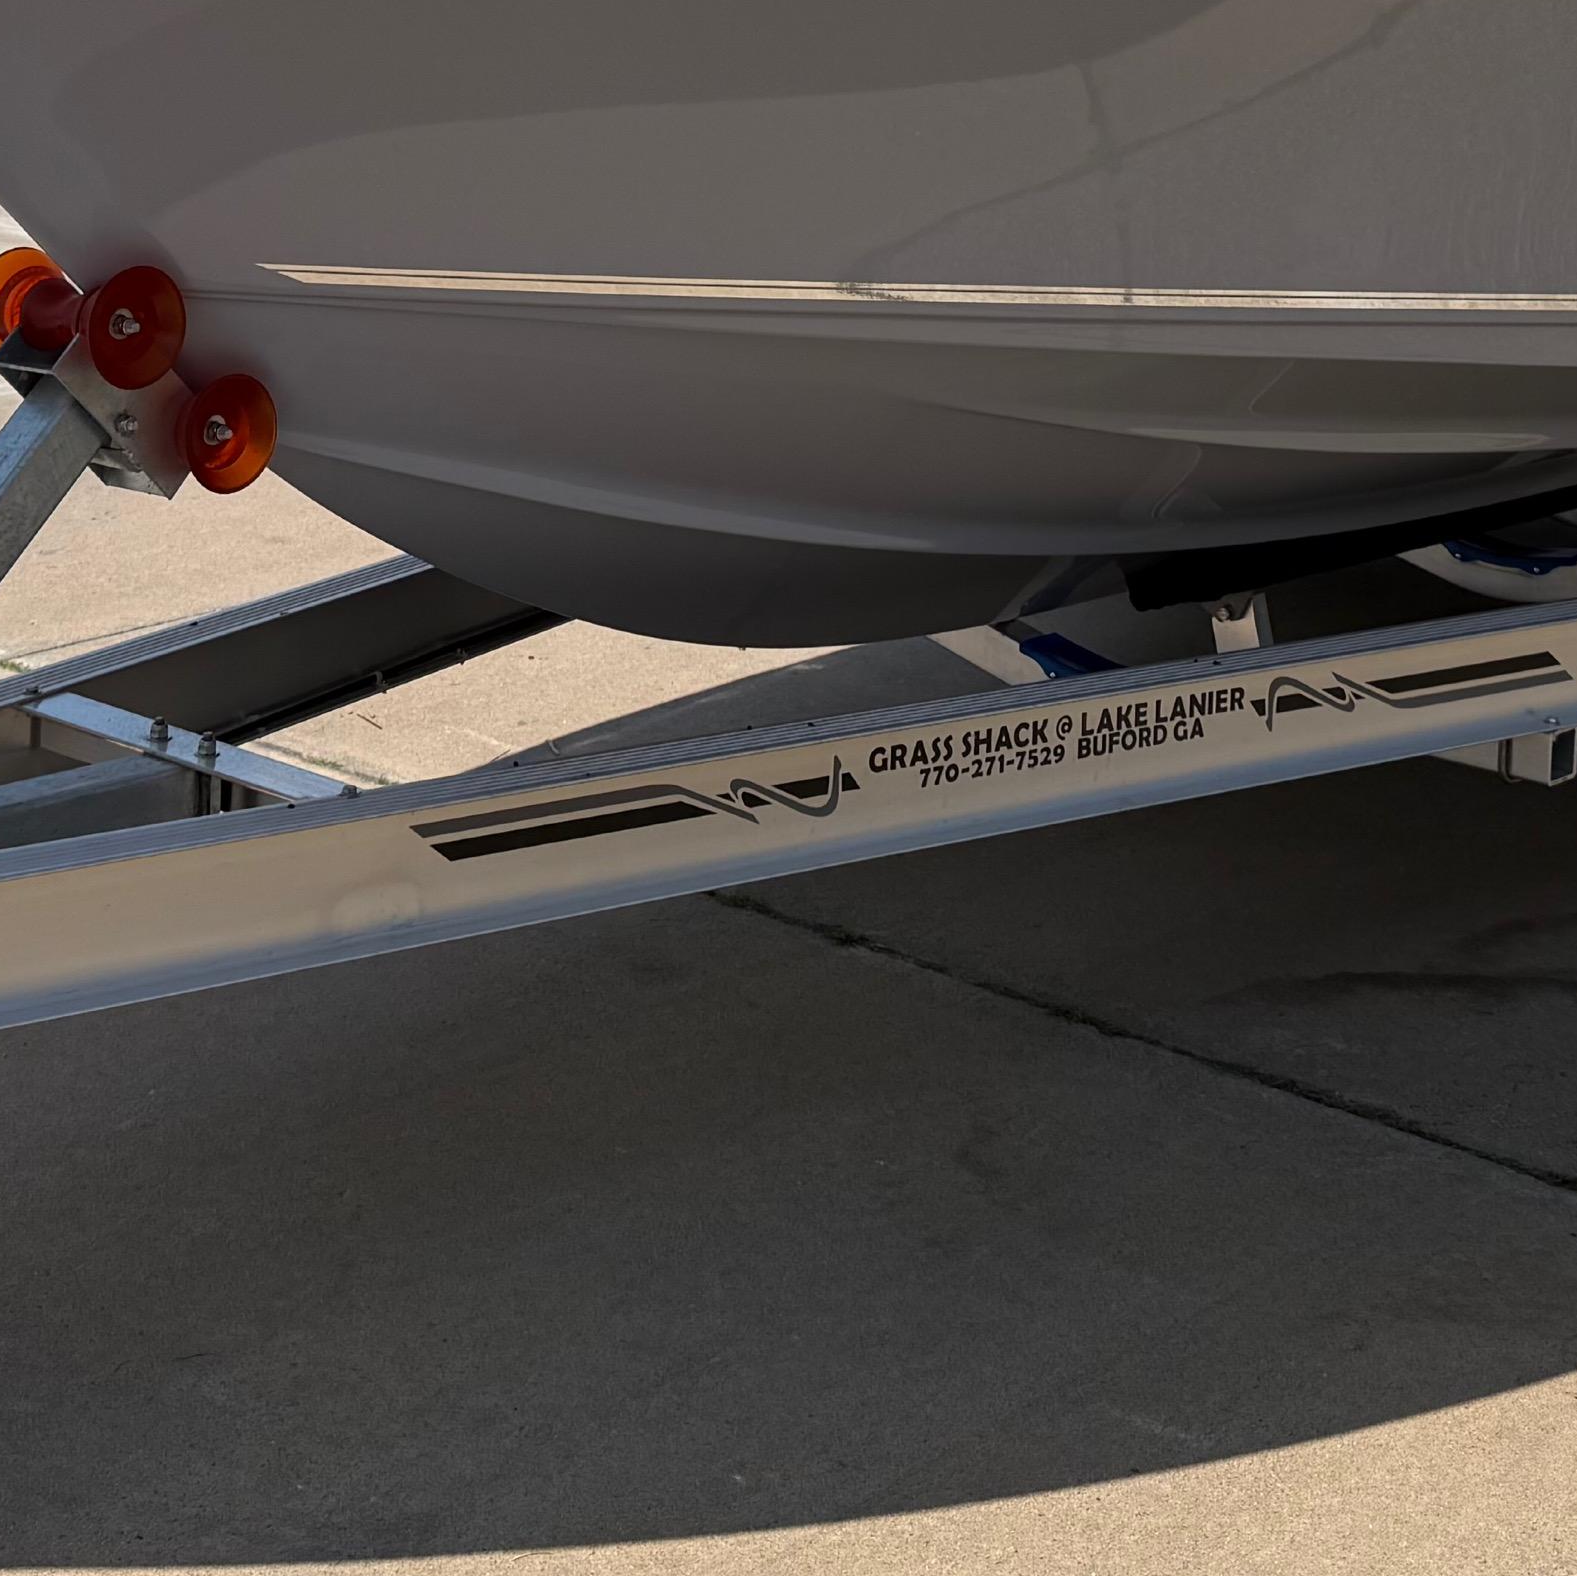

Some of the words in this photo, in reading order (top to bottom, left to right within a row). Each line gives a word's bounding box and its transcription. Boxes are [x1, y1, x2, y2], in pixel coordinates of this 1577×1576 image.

[868, 734, 954, 774] GRASS
[961, 718, 1049, 757] SHACK
[1055, 714, 1074, 741] @
[1080, 702, 1148, 737] LAKE
[1155, 687, 1246, 723] LANIER
[919, 743, 1066, 789] 770-271-7529
[1077, 724, 1168, 760] BUFORD
[1173, 717, 1204, 743] GA
